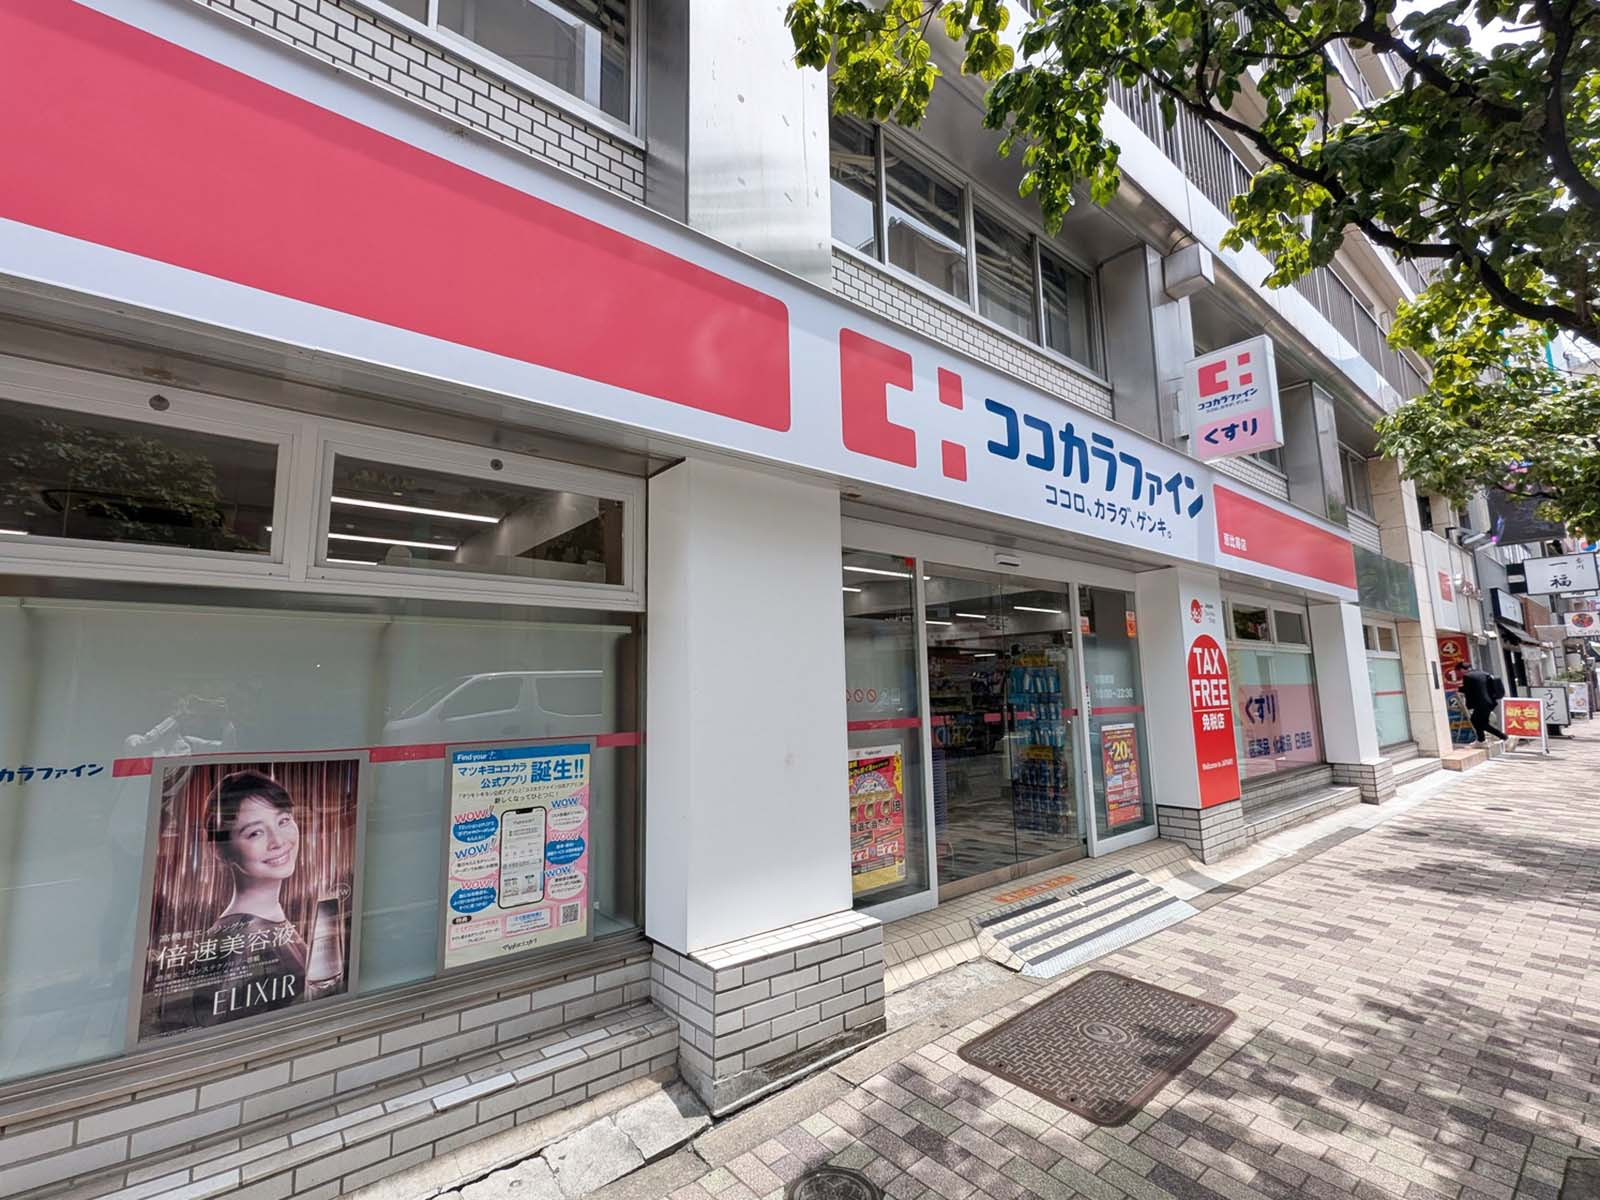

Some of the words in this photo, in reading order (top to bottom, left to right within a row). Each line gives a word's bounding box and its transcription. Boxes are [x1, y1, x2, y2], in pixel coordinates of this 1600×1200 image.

[1198, 387, 1258, 411] ココカラファイン
[1204, 417, 1258, 445] くすり
[985, 398, 1204, 519] ココカラファイン
[1045, 484, 1173, 540] ココロ、カラダ、ゲンキ。
[1193, 647, 1222, 676] TAX
[1192, 679, 1229, 707] FREE
[1544, 689, 1561, 722] うどん
[1202, 713, 1225, 731] 免税店
[1245, 693, 1275, 724] くすり
[458, 762, 527, 777] マツキヨココカラ
[480, 774, 527, 789] 公式アプリ
[530, 758, 584, 784] 誕生!!
[156, 923, 297, 971] 倍速美容液
[213, 973, 296, 1016] ELIXIR
